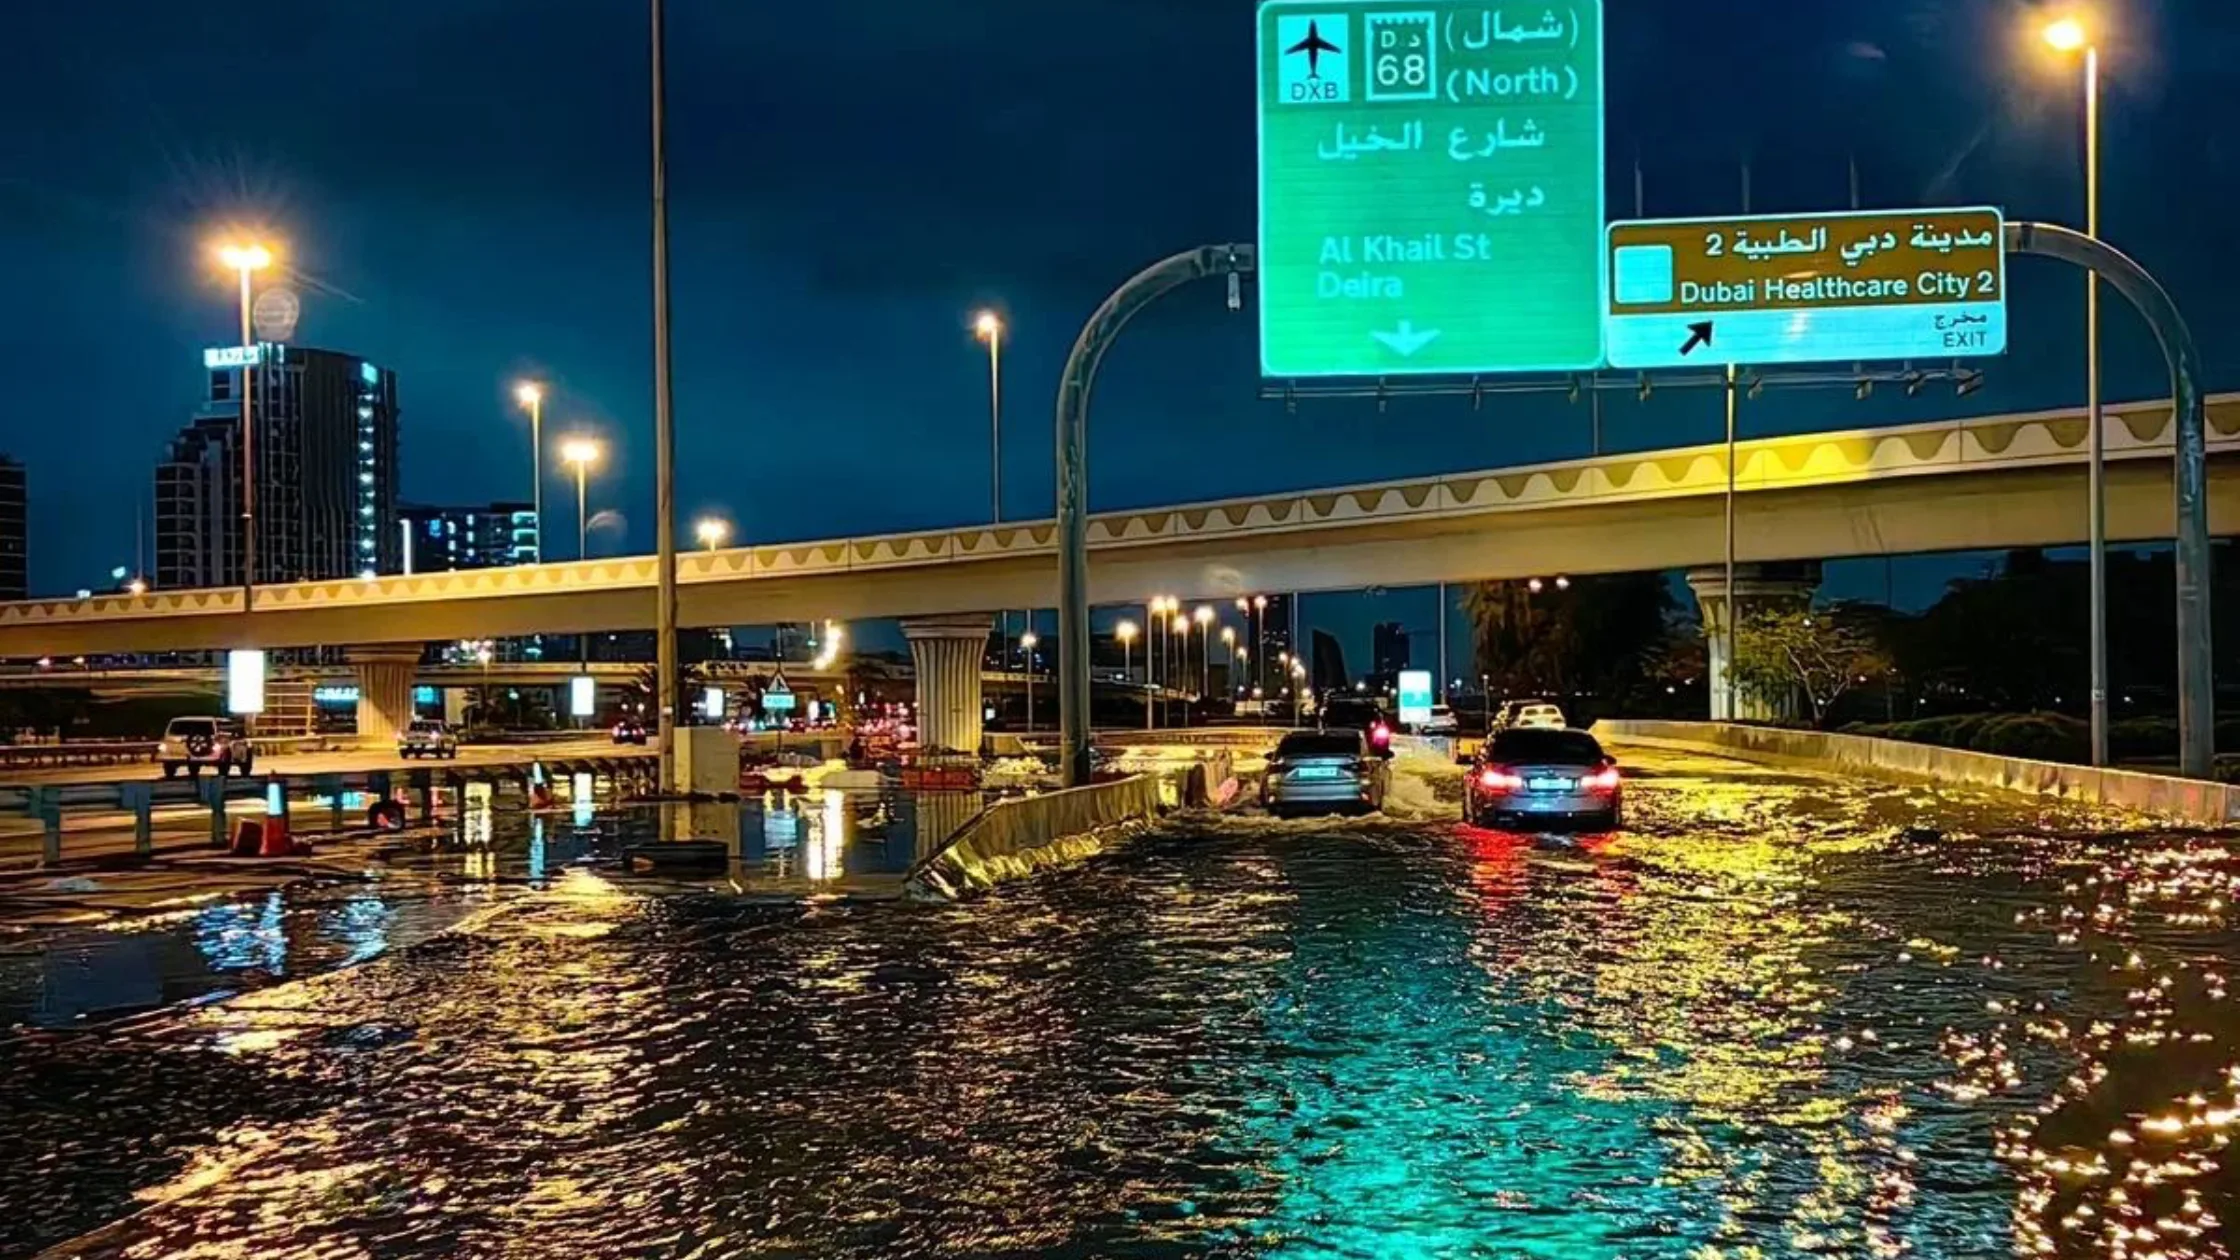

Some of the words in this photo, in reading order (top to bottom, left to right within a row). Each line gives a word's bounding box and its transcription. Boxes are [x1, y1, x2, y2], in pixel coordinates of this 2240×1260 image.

[1380, 30, 1397, 48] D
[1377, 54, 1426, 86] 68
[1445, 66, 1579, 103] (North)
[1291, 82, 1339, 101] DXB
[1317, 120, 1422, 160] الخيل
[1448, 118, 1545, 161] شارع
[1467, 182, 1546, 216] ديرة
[1318, 235, 1353, 265] Al
[1363, 233, 1445, 262] Khail
[1453, 232, 1492, 261] St
[1704, 233, 1724, 257] 2
[1732, 225, 1827, 261] الطبية
[1840, 230, 1896, 267] دبي
[1909, 222, 1994, 254] مدينة
[1317, 271, 1404, 299] Deira
[1680, 279, 1755, 304] Dubai
[1764, 274, 1908, 301] Healthcare
[1916, 272, 1971, 299] City
[1976, 271, 1994, 294] 2
[1934, 310, 1988, 330] مخرج
[1943, 331, 1988, 347] EXIT
